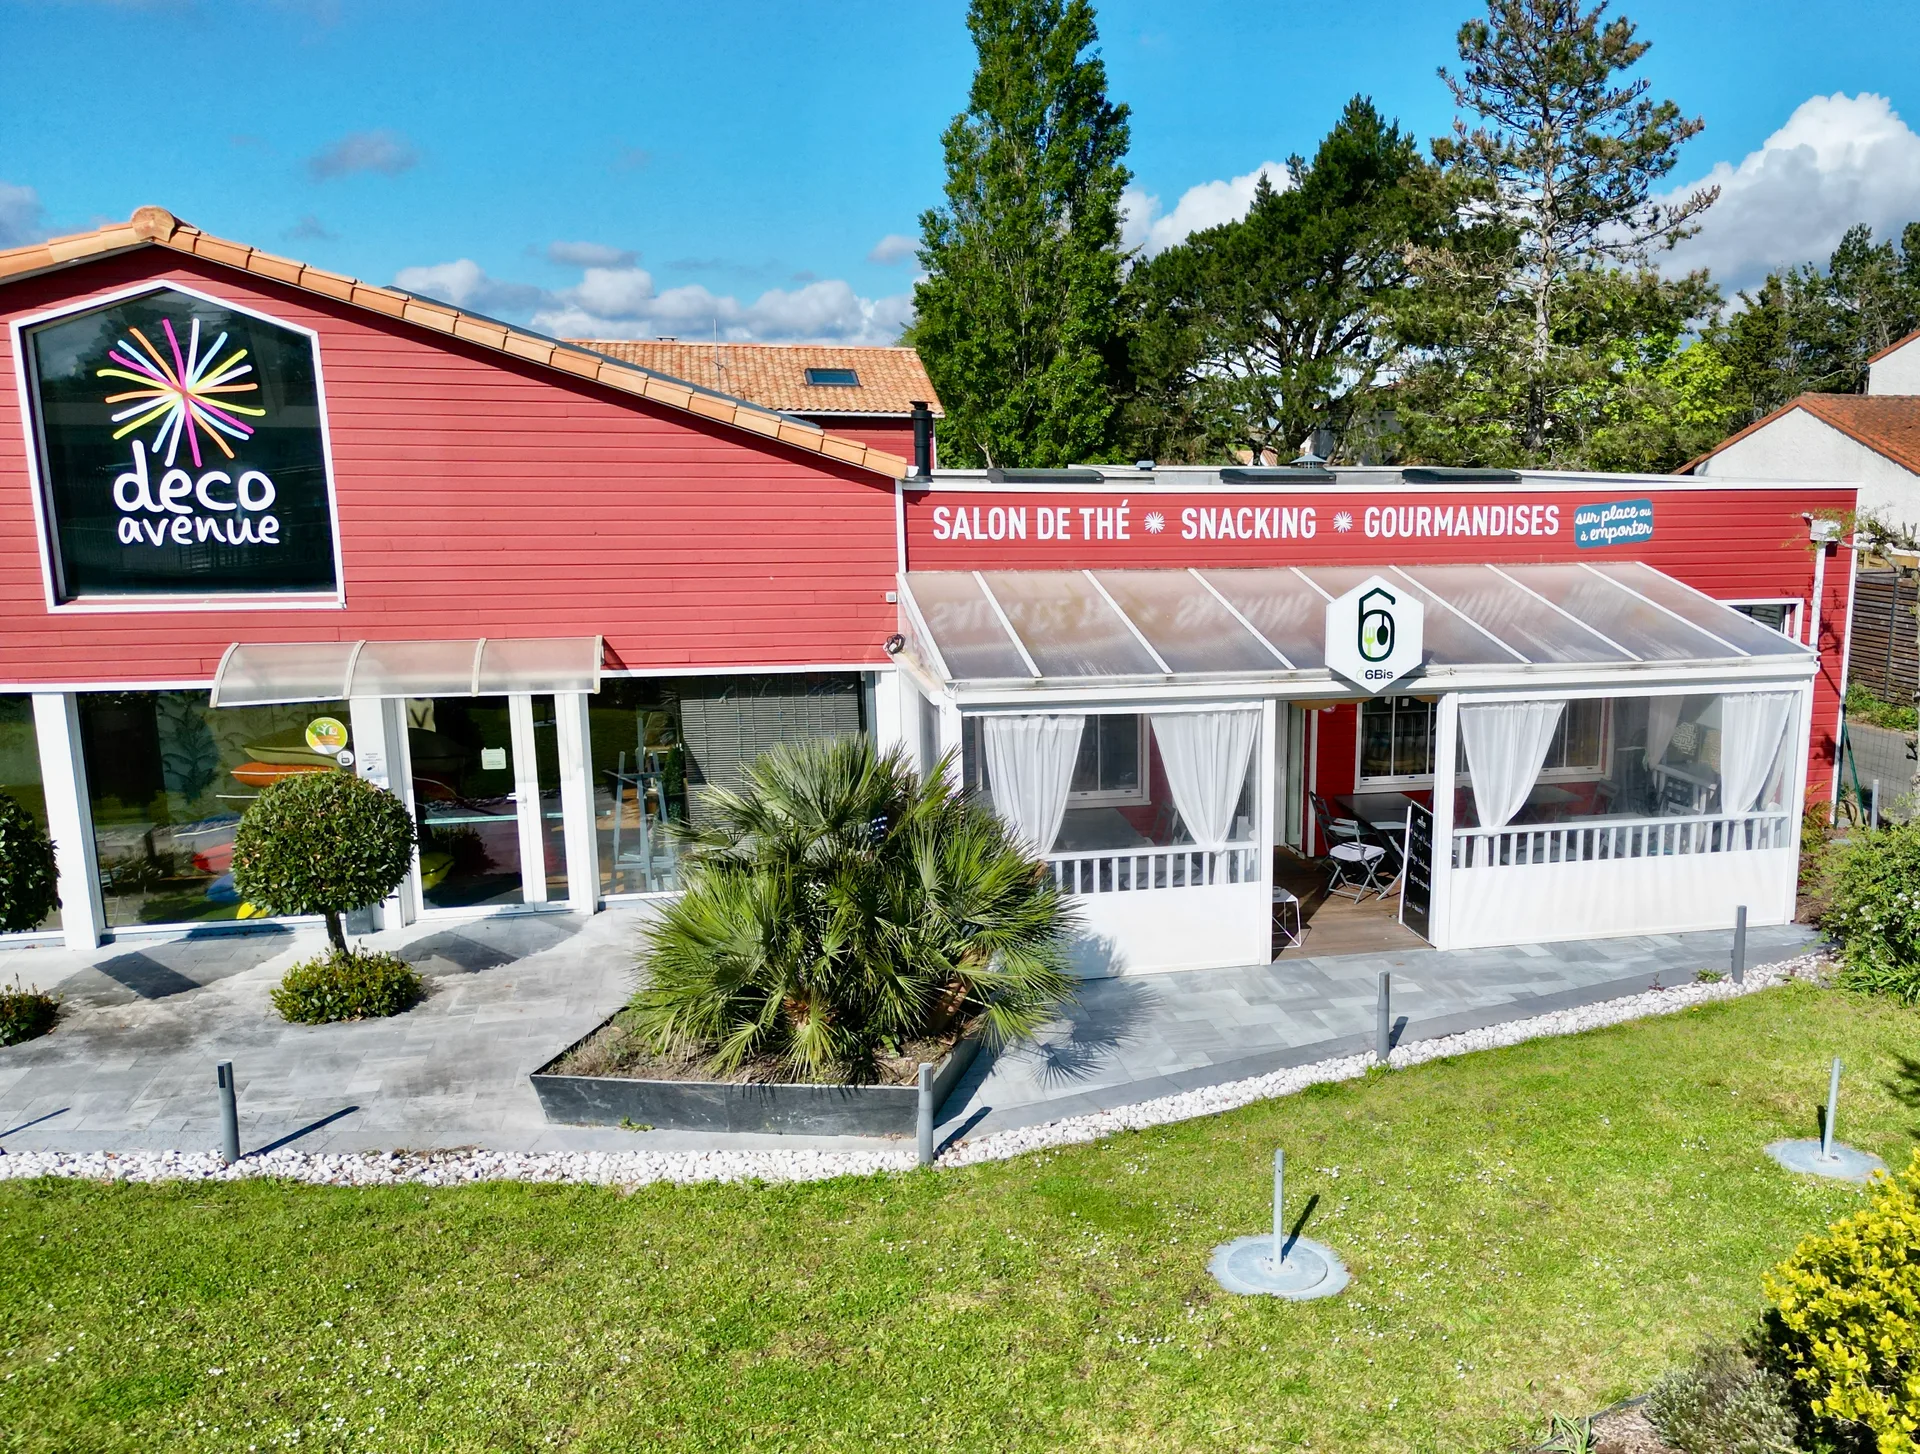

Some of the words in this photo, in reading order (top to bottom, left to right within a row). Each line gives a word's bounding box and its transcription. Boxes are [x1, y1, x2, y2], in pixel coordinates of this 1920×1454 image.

[118, 515, 280, 547] avenue
[933, 507, 1027, 541] SALON
[1037, 507, 1071, 541] DE
[1079, 499, 1131, 541] THÉ
[1181, 507, 1317, 540] SNACKING
[1364, 504, 1560, 538] GOURMANDISES
[1575, 511, 1600, 525] sur
[1601, 504, 1638, 528] place
[1639, 508, 1652, 517] ou
[1580, 530, 1589, 541] à
[1589, 519, 1653, 544] emporter
